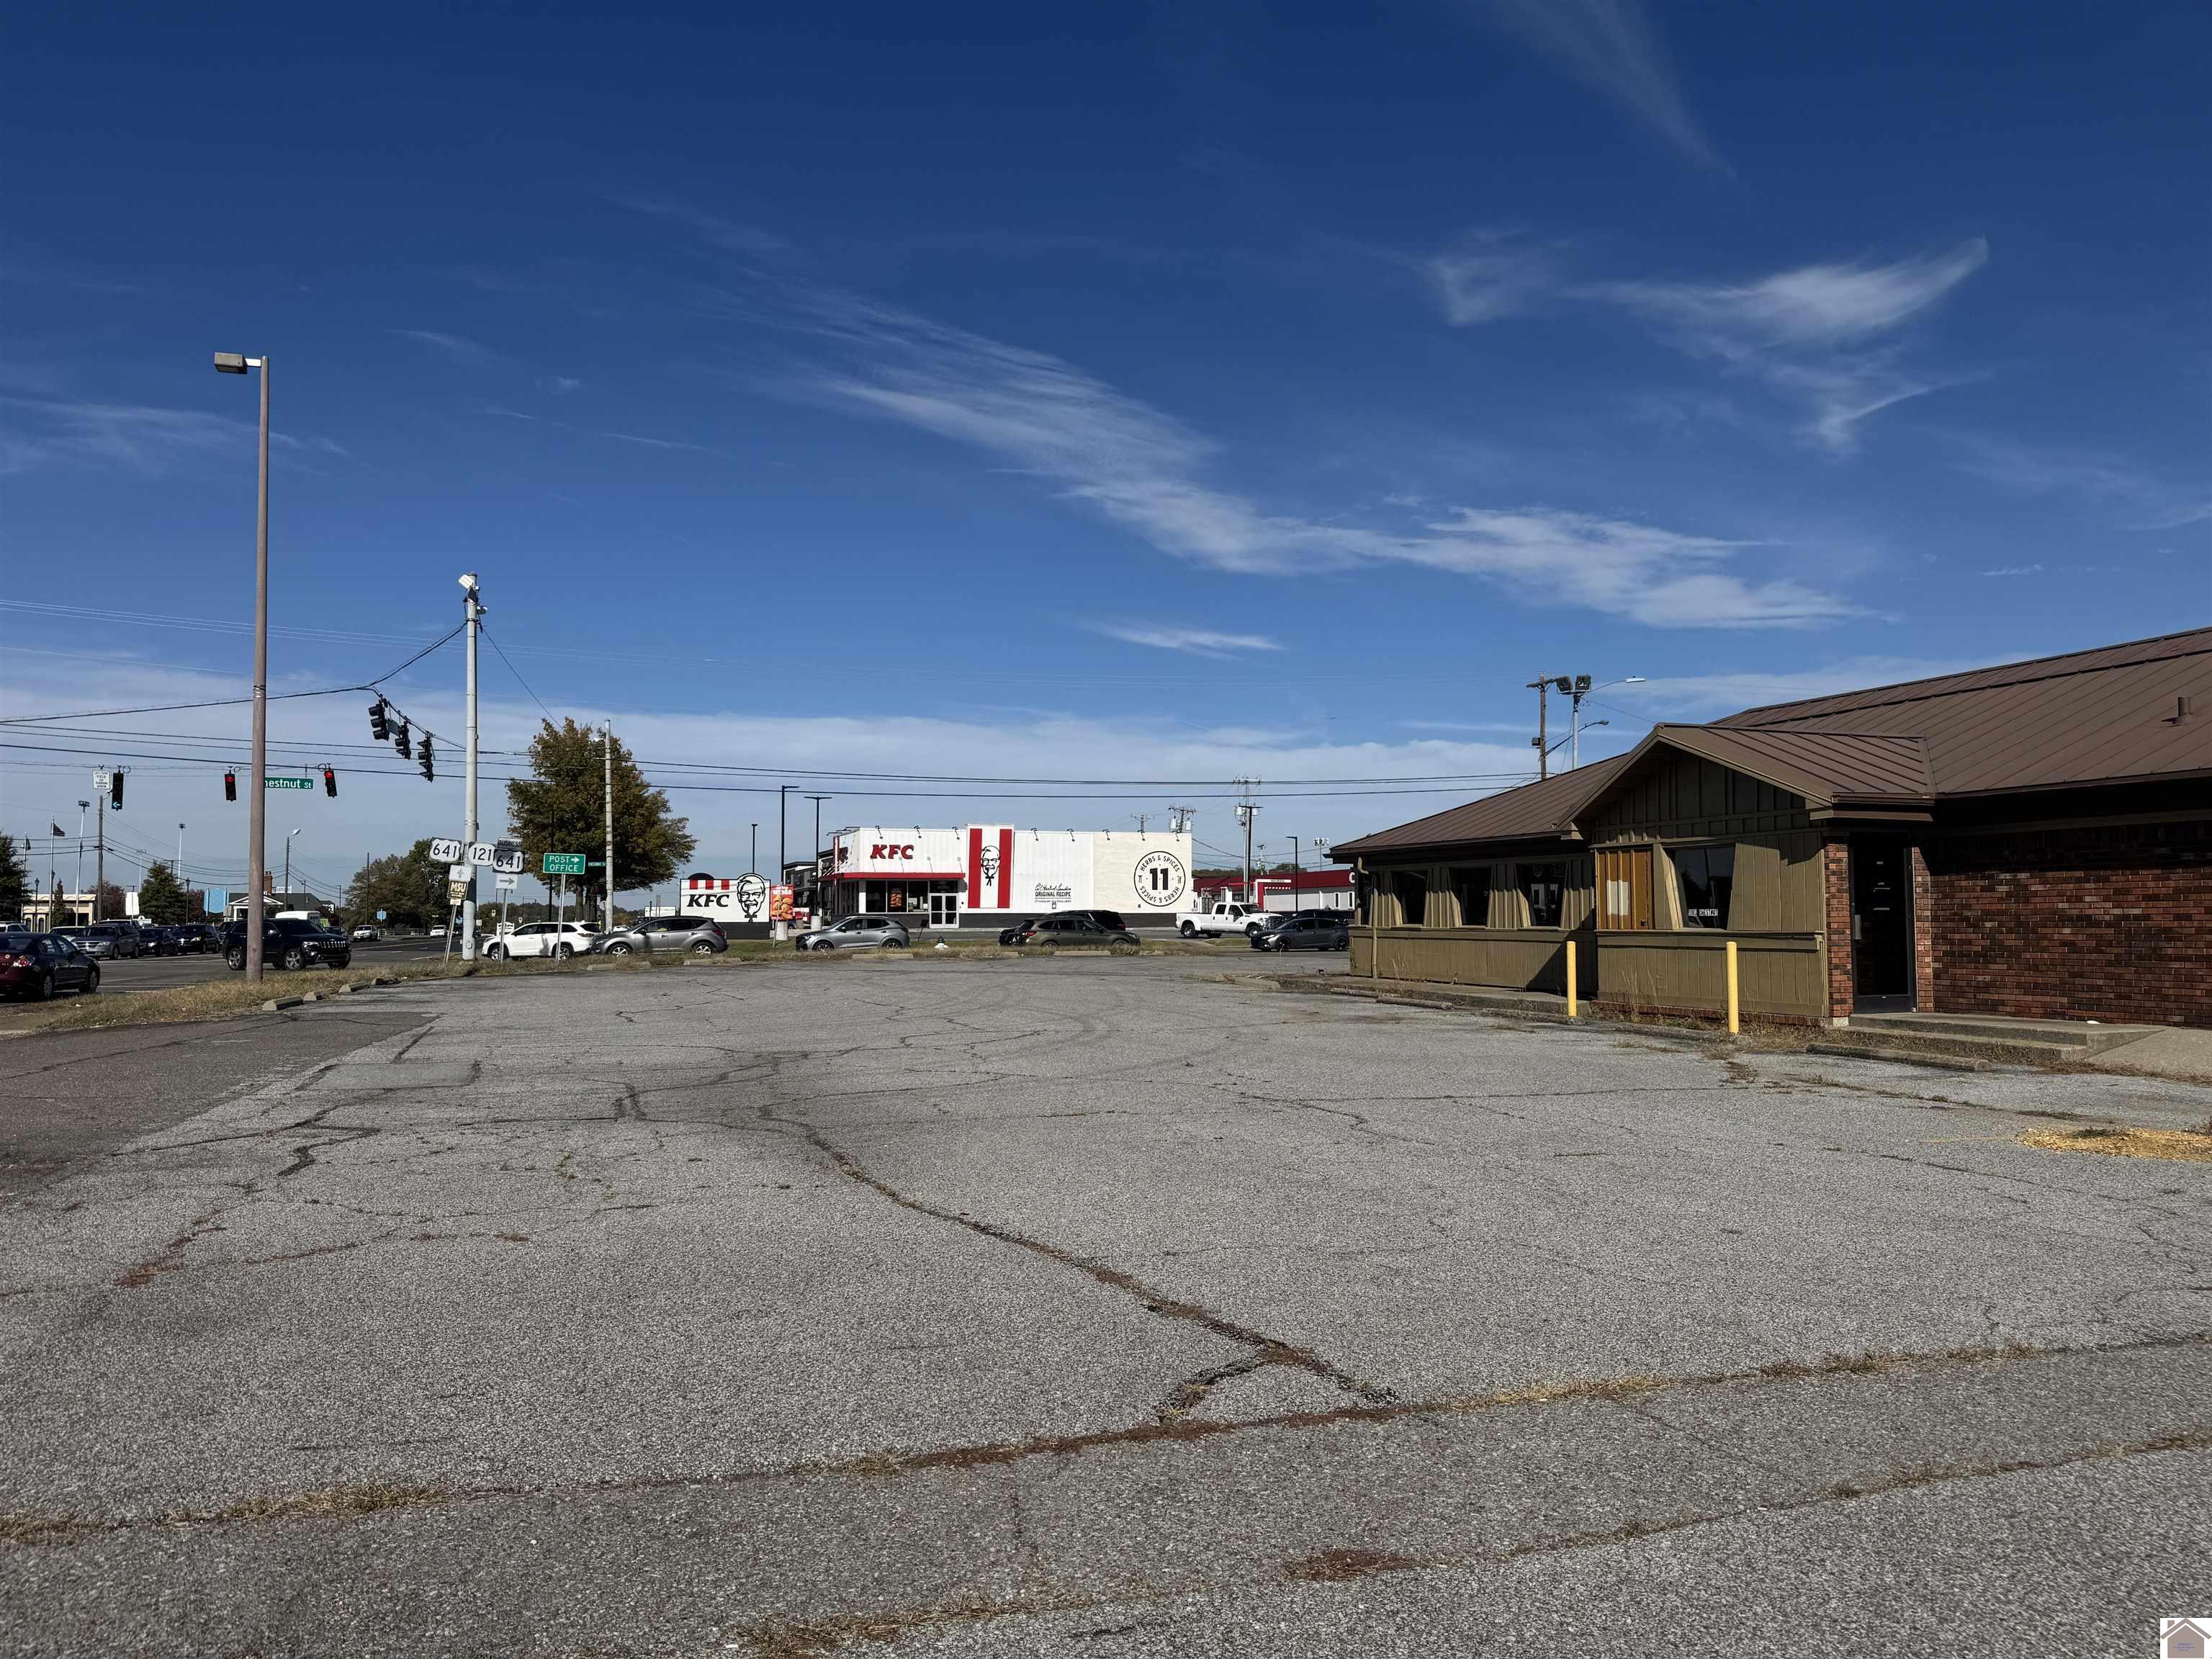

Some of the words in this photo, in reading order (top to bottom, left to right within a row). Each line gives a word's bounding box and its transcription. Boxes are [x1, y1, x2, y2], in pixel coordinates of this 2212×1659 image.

[265, 779, 300, 788] estnut
[433, 843, 457, 858] 641
[498, 840, 522, 848] BUSINESS
[472, 847, 493, 862] 121
[870, 844, 914, 860] KFC
[495, 854, 521, 868] 641
[1140, 855, 1156, 871] HERBS
[1163, 855, 1180, 872] SPICES
[1149, 868, 1169, 890] 11
[450, 881, 467, 893] MSU
[1139, 886, 1156, 903] SPICES
[1164, 886, 1180, 902] HERBS
[686, 894, 730, 907] KFC
